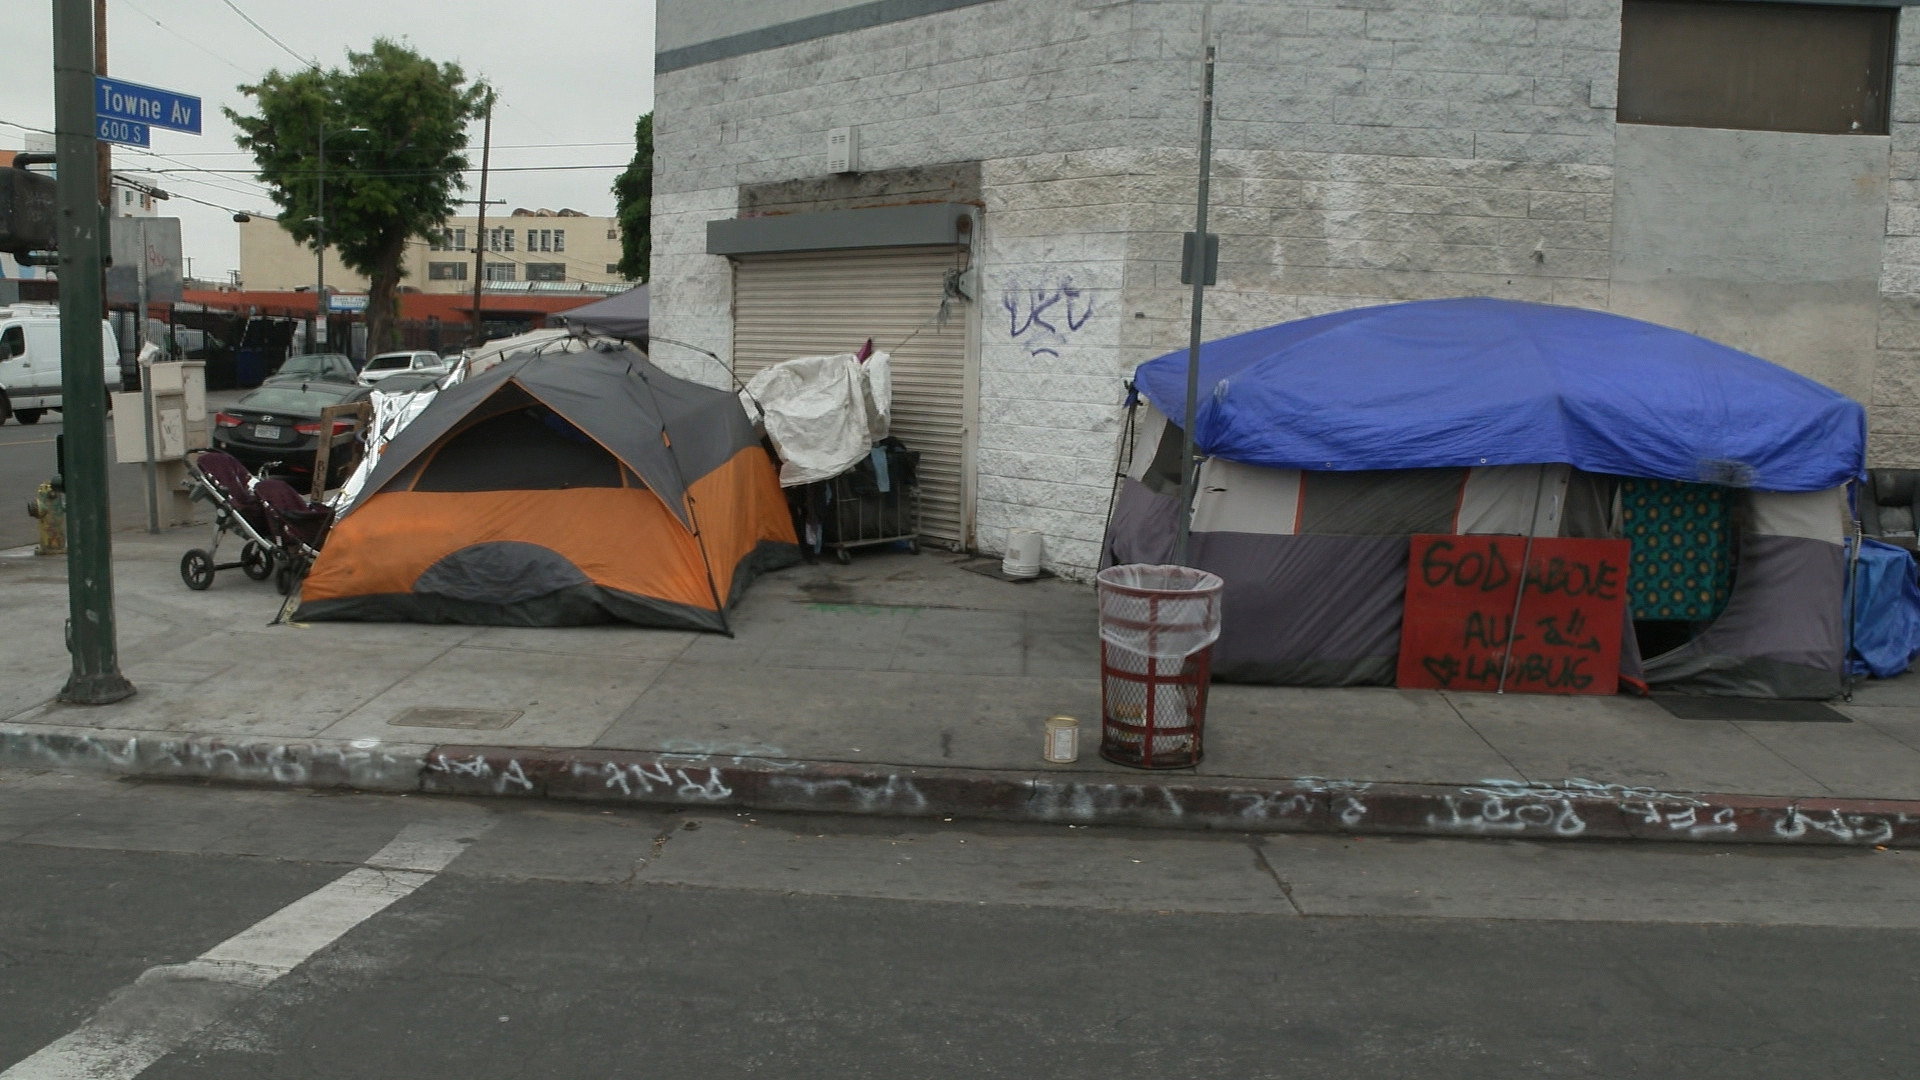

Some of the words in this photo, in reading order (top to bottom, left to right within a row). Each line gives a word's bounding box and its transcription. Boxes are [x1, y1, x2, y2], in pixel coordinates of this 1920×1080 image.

[102, 84, 161, 119] Towne
[171, 100, 191, 125] Av
[101, 120, 128, 140] 600
[134, 126, 141, 142] S
[1422, 541, 1511, 592] GOD
[1463, 611, 1524, 649] ALL
